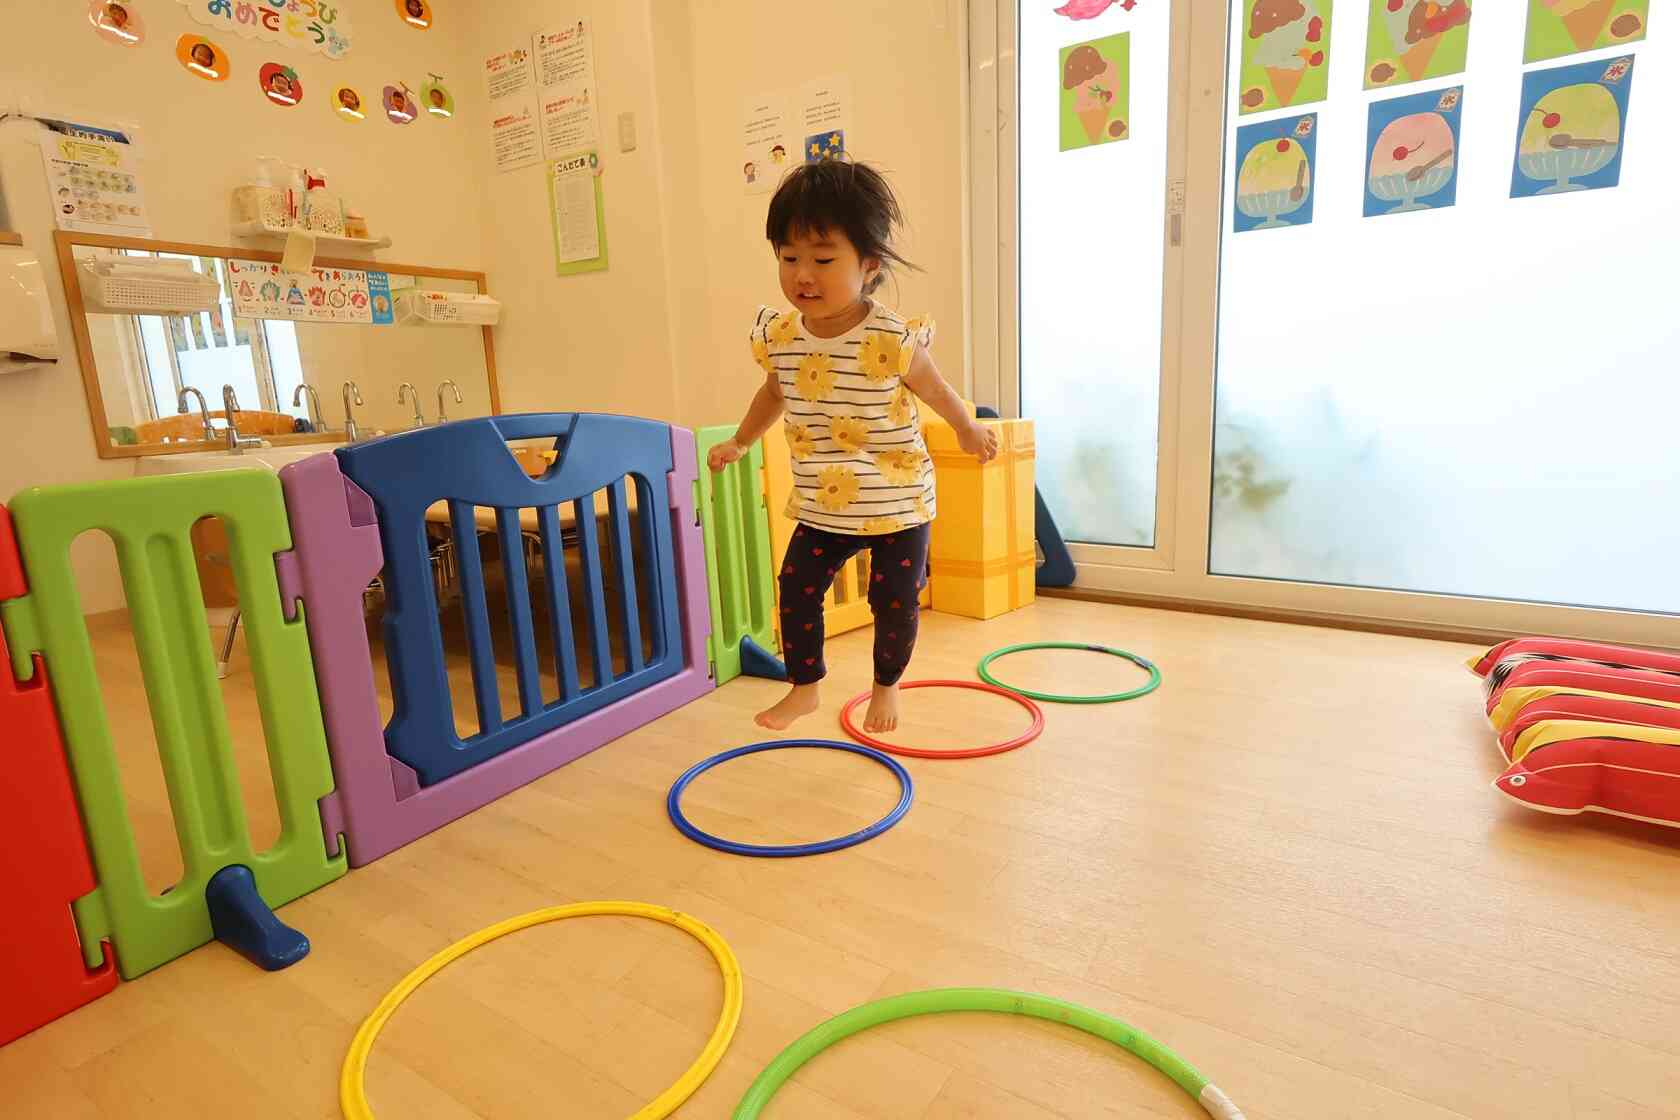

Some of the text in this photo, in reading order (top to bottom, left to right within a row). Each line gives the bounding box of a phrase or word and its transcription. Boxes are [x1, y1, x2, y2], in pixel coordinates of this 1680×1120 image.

[207, 0, 325, 43] おめでとう
